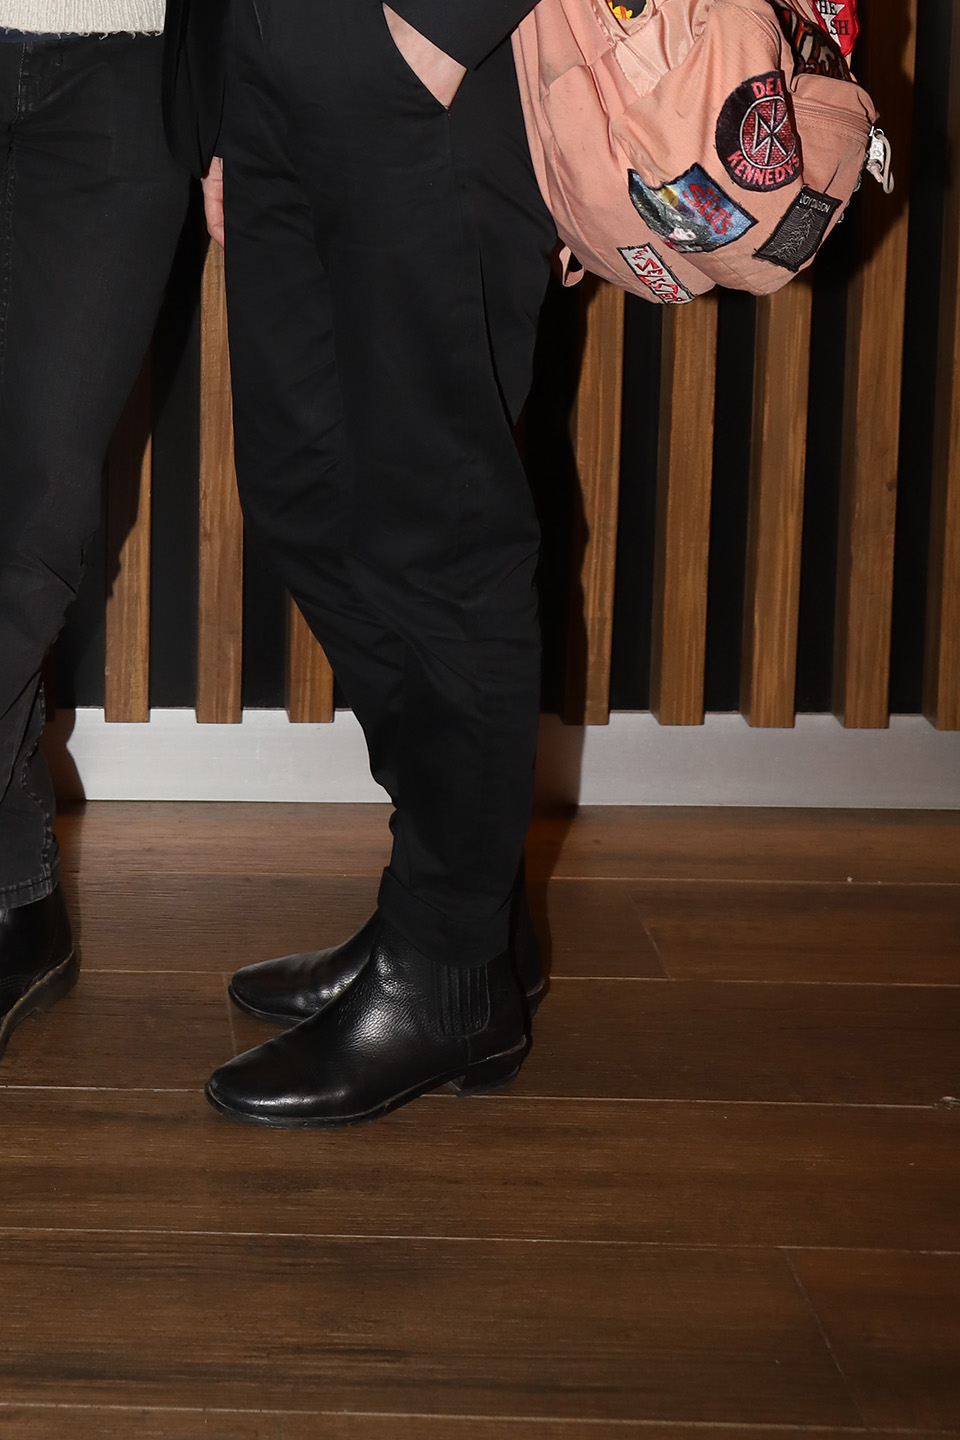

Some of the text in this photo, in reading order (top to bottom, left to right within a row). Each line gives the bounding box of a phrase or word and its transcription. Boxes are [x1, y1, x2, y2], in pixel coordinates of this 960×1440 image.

[815, 0, 838, 15] HE
[751, 77, 785, 99] DEA
[727, 150, 800, 186] KENNEDYS
